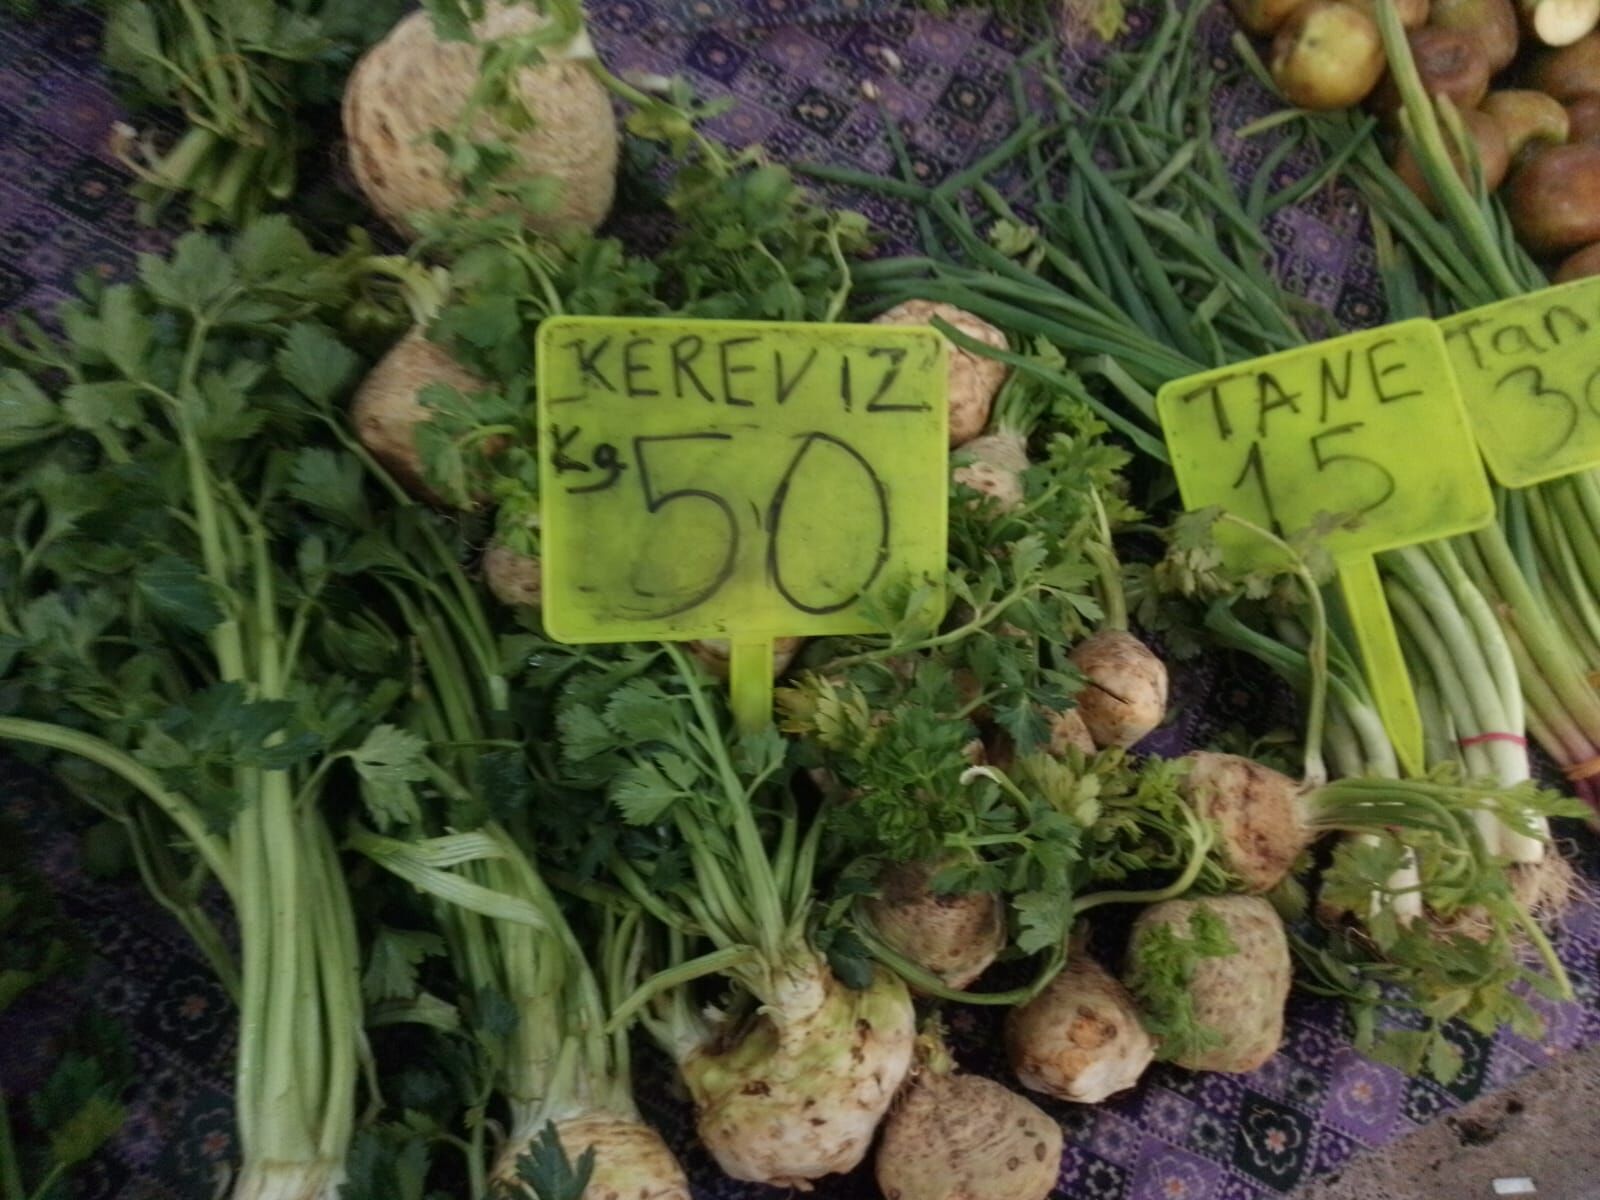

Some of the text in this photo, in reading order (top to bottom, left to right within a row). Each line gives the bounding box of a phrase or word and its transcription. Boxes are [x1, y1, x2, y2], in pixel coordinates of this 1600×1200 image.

[560, 334, 932, 413] KEREVIZ
[1444, 304, 1600, 371] Tan
[1182, 340, 1424, 441] TANE
[1492, 363, 1600, 472] 3
[551, 423, 890, 621] Kg 50
[1233, 421, 1396, 539] 15
